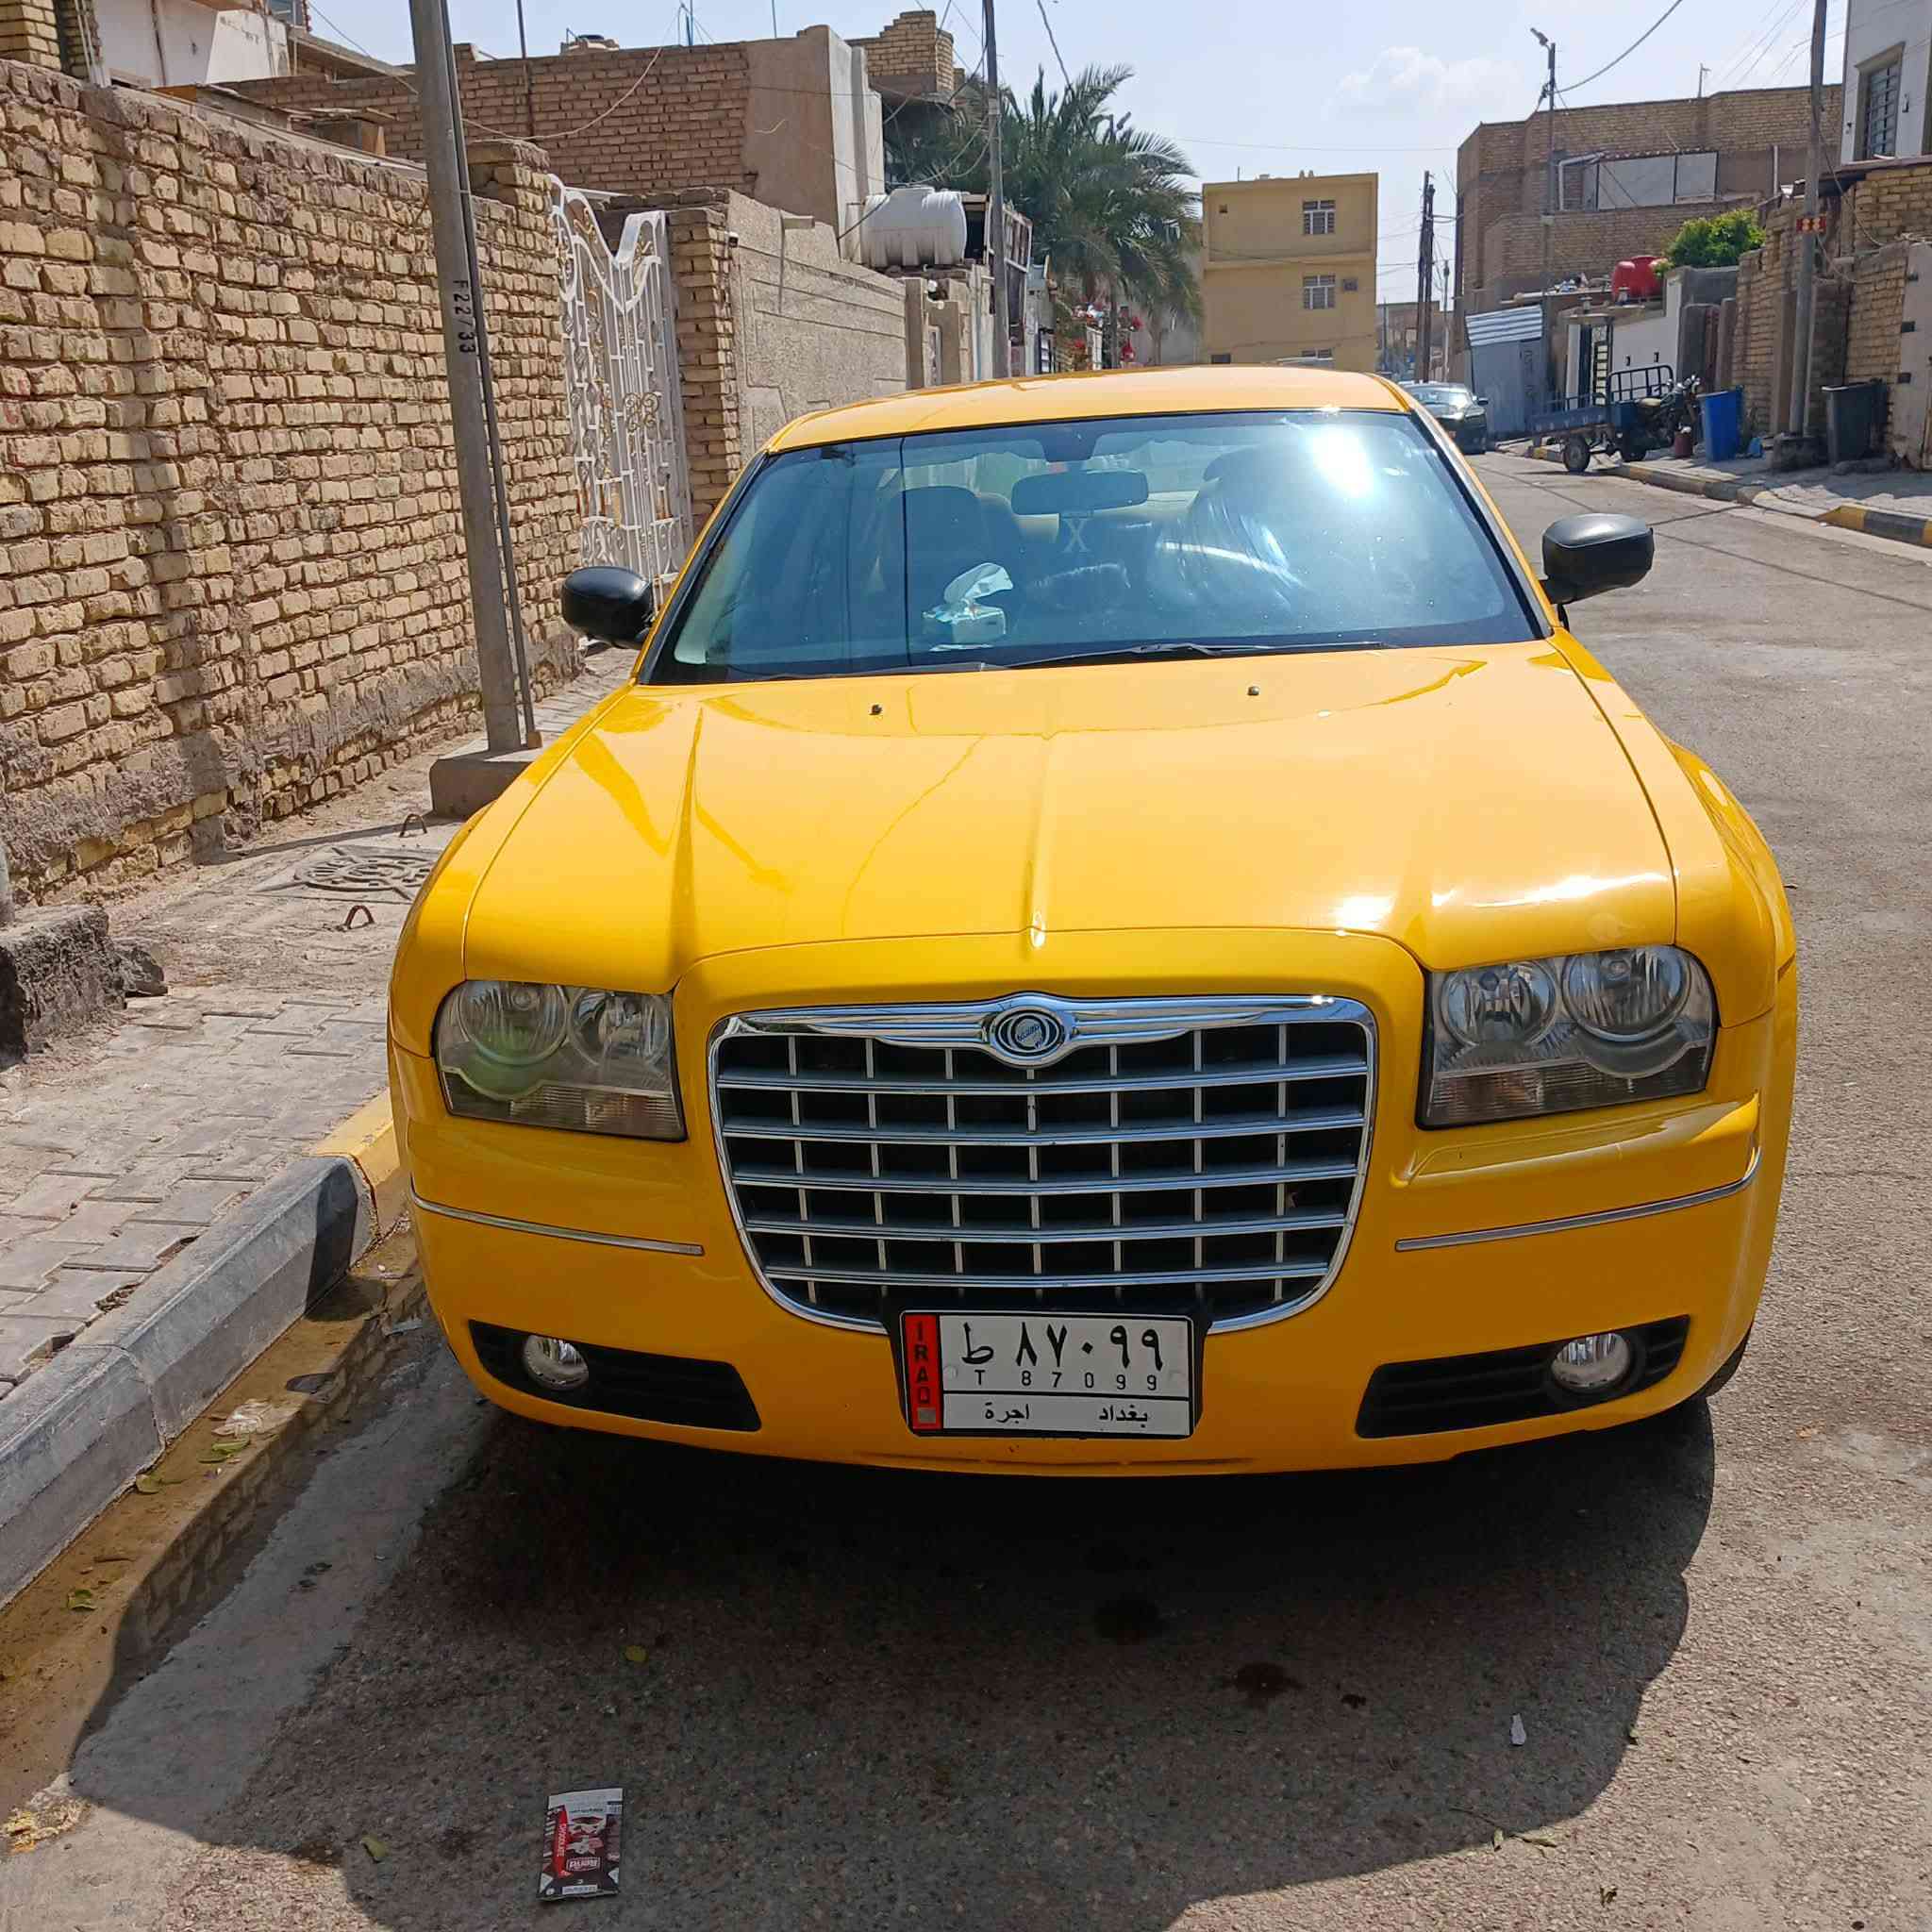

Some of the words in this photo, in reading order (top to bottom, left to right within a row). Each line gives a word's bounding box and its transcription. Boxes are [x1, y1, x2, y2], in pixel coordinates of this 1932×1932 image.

[453, 280, 476, 353] F22/33
[974, 1370, 985, 1385] T
[1022, 1371, 1158, 1391] 87099
[1099, 1405, 1148, 1427] بغداد
